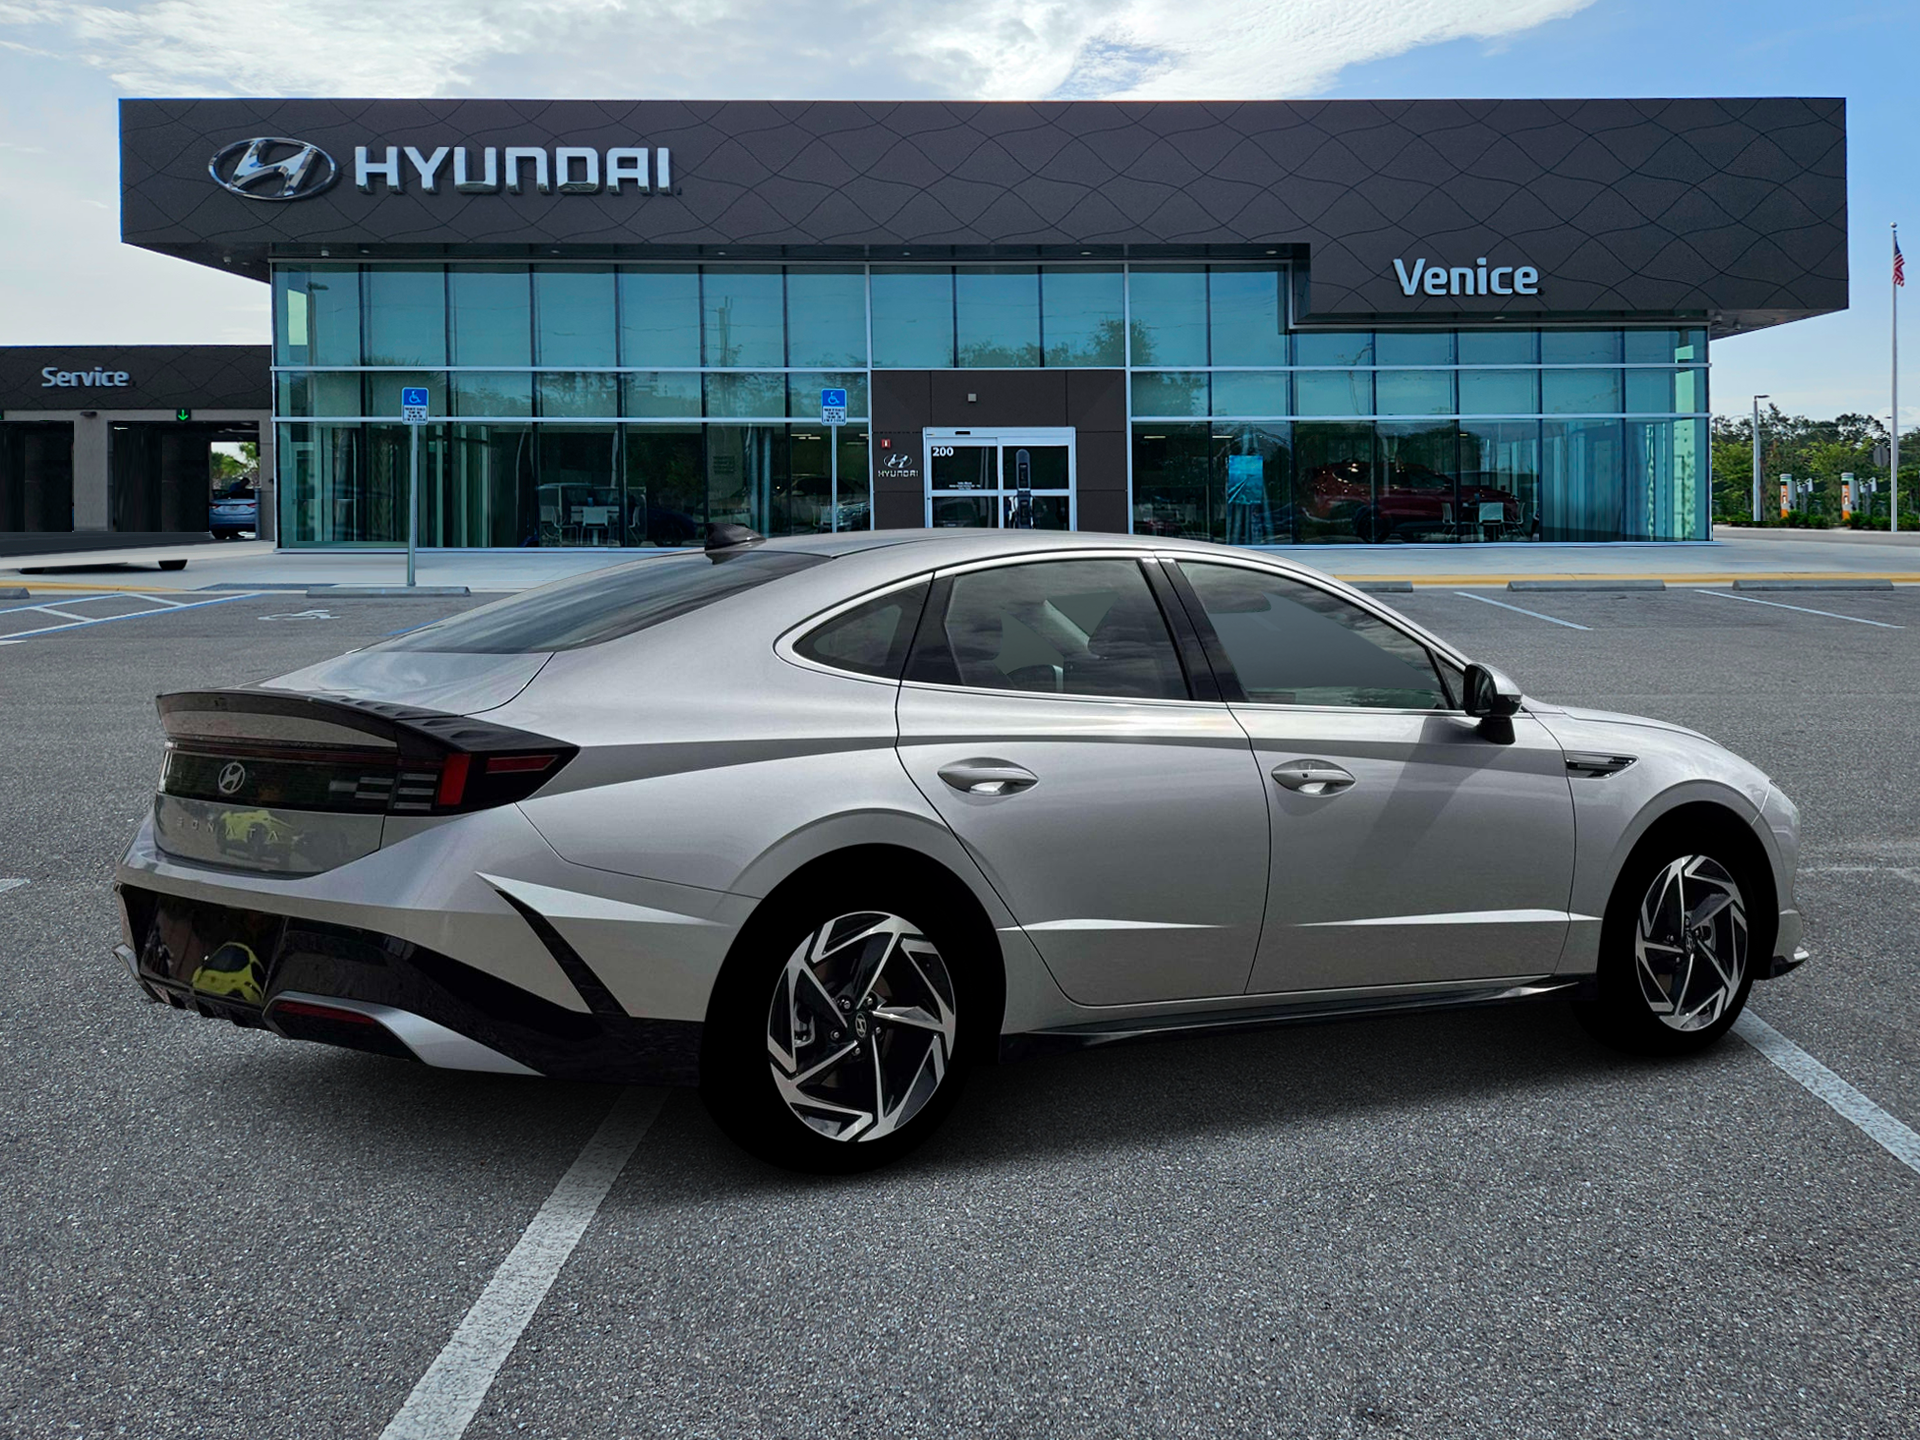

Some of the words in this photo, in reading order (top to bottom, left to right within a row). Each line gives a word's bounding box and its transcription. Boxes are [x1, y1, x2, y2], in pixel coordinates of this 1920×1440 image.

[354, 146, 671, 194] HYUNDAI
[1392, 257, 1539, 296] Venice
[41, 366, 130, 387] Service
[932, 446, 954, 457] 200
[877, 470, 919, 478] HYUNDAI
[176, 816, 279, 841] SONATA
